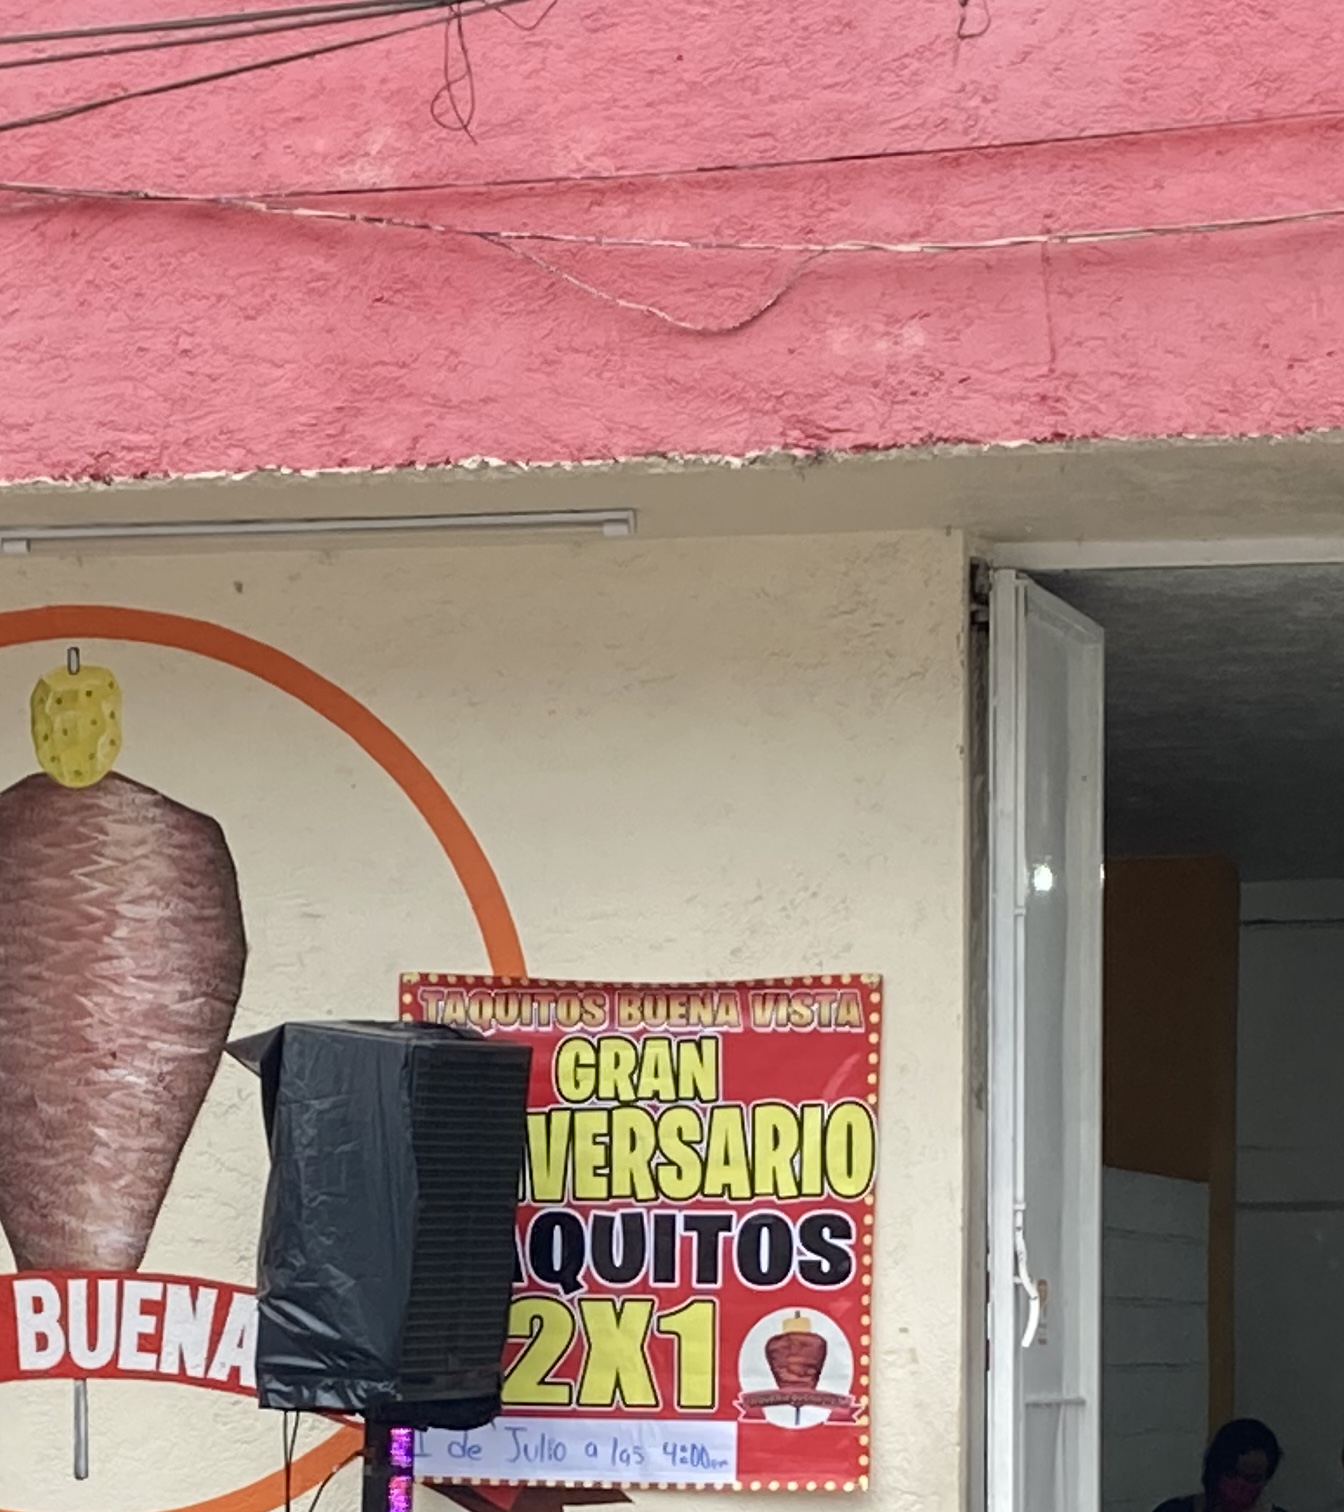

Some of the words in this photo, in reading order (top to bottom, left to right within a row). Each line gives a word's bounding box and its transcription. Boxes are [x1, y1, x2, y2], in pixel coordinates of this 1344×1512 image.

[419, 987, 607, 1034] TAQUITOS
[616, 990, 741, 1032] BUENA
[751, 989, 863, 1032] VISTA
[556, 1036, 720, 1104] GRAN
[518, 1100, 878, 1203] VERSARIO
[514, 1209, 854, 1299] QUITOS
[12, 1277, 258, 1386] BUENA
[503, 1295, 719, 1411] 2X1
[446, 1429, 483, 1462] de
[504, 1426, 567, 1464] Julio
[584, 1439, 599, 1458] a
[611, 1436, 646, 1466] las
